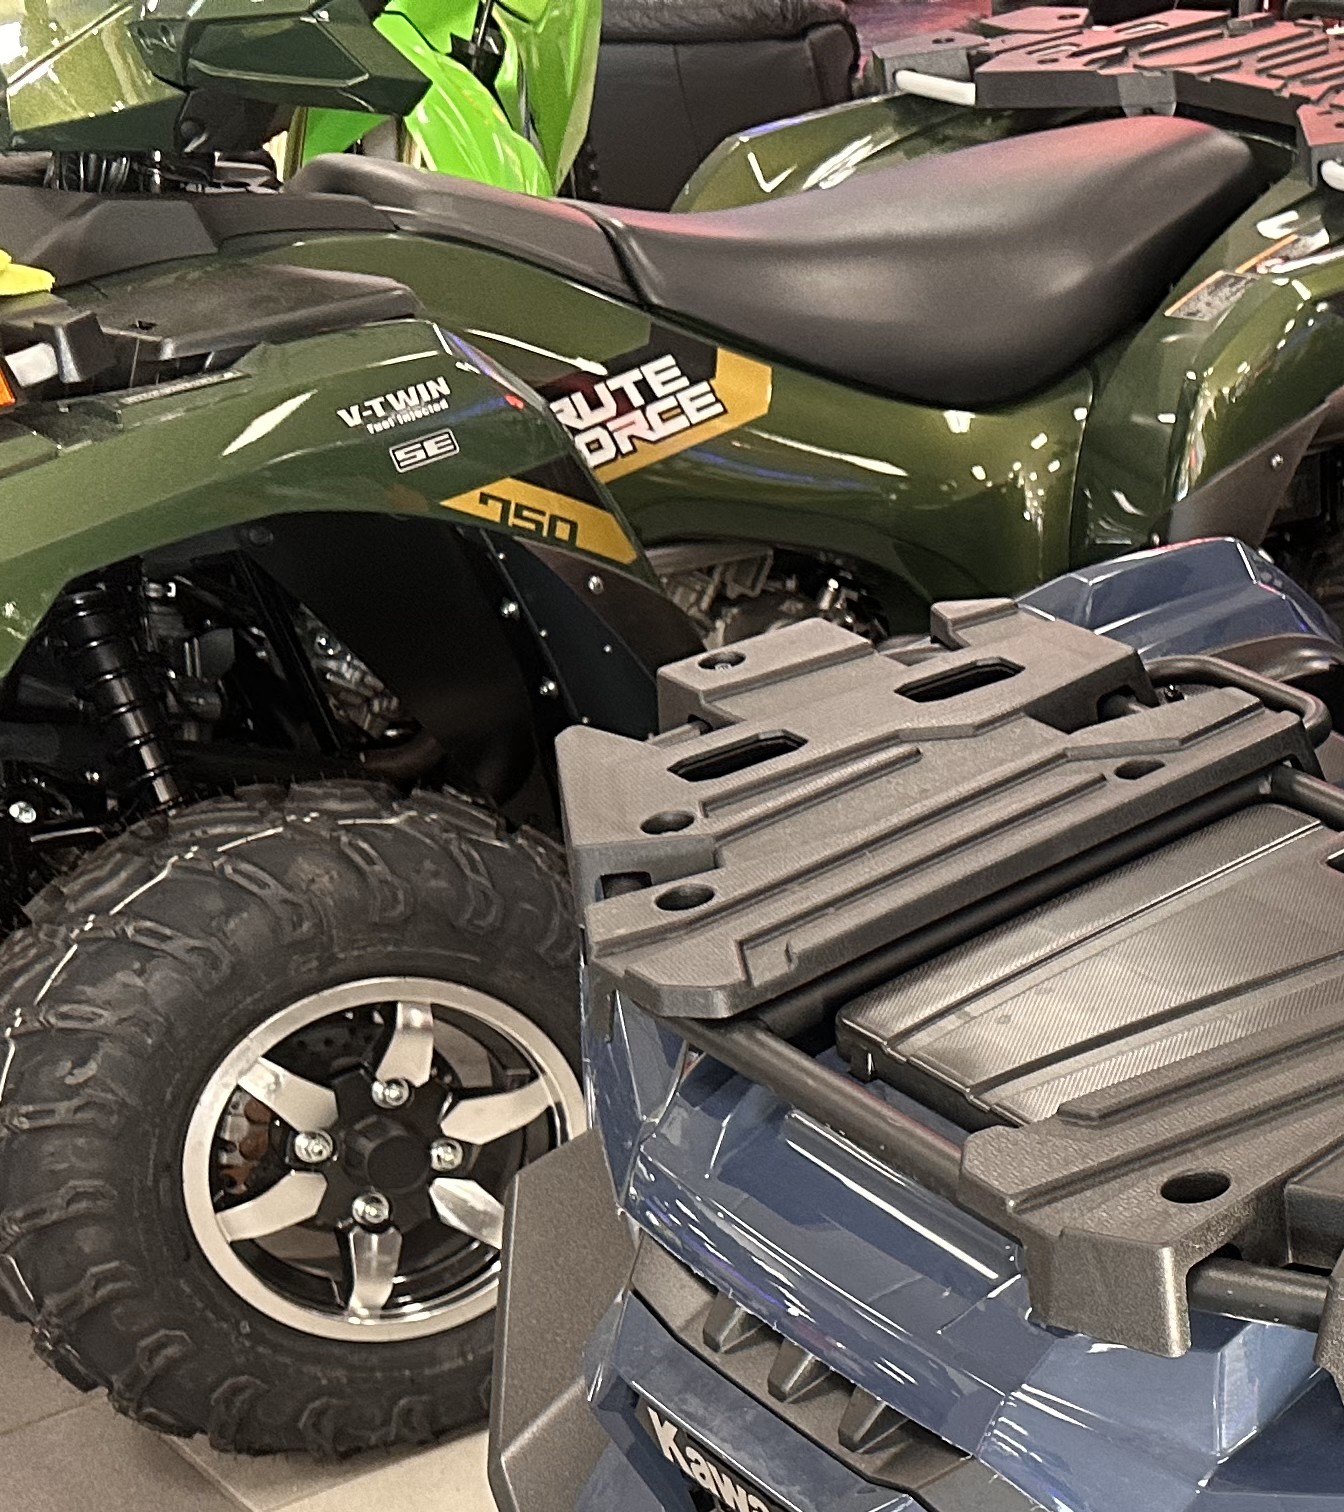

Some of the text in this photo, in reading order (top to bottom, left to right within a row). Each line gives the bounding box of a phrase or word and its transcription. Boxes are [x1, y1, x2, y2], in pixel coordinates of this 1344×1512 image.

[336, 375, 451, 428] V-TWIN
[549, 353, 690, 431] RUTE
[394, 433, 456, 468] SE
[584, 380, 729, 469] ORCE
[478, 491, 580, 546] 750
